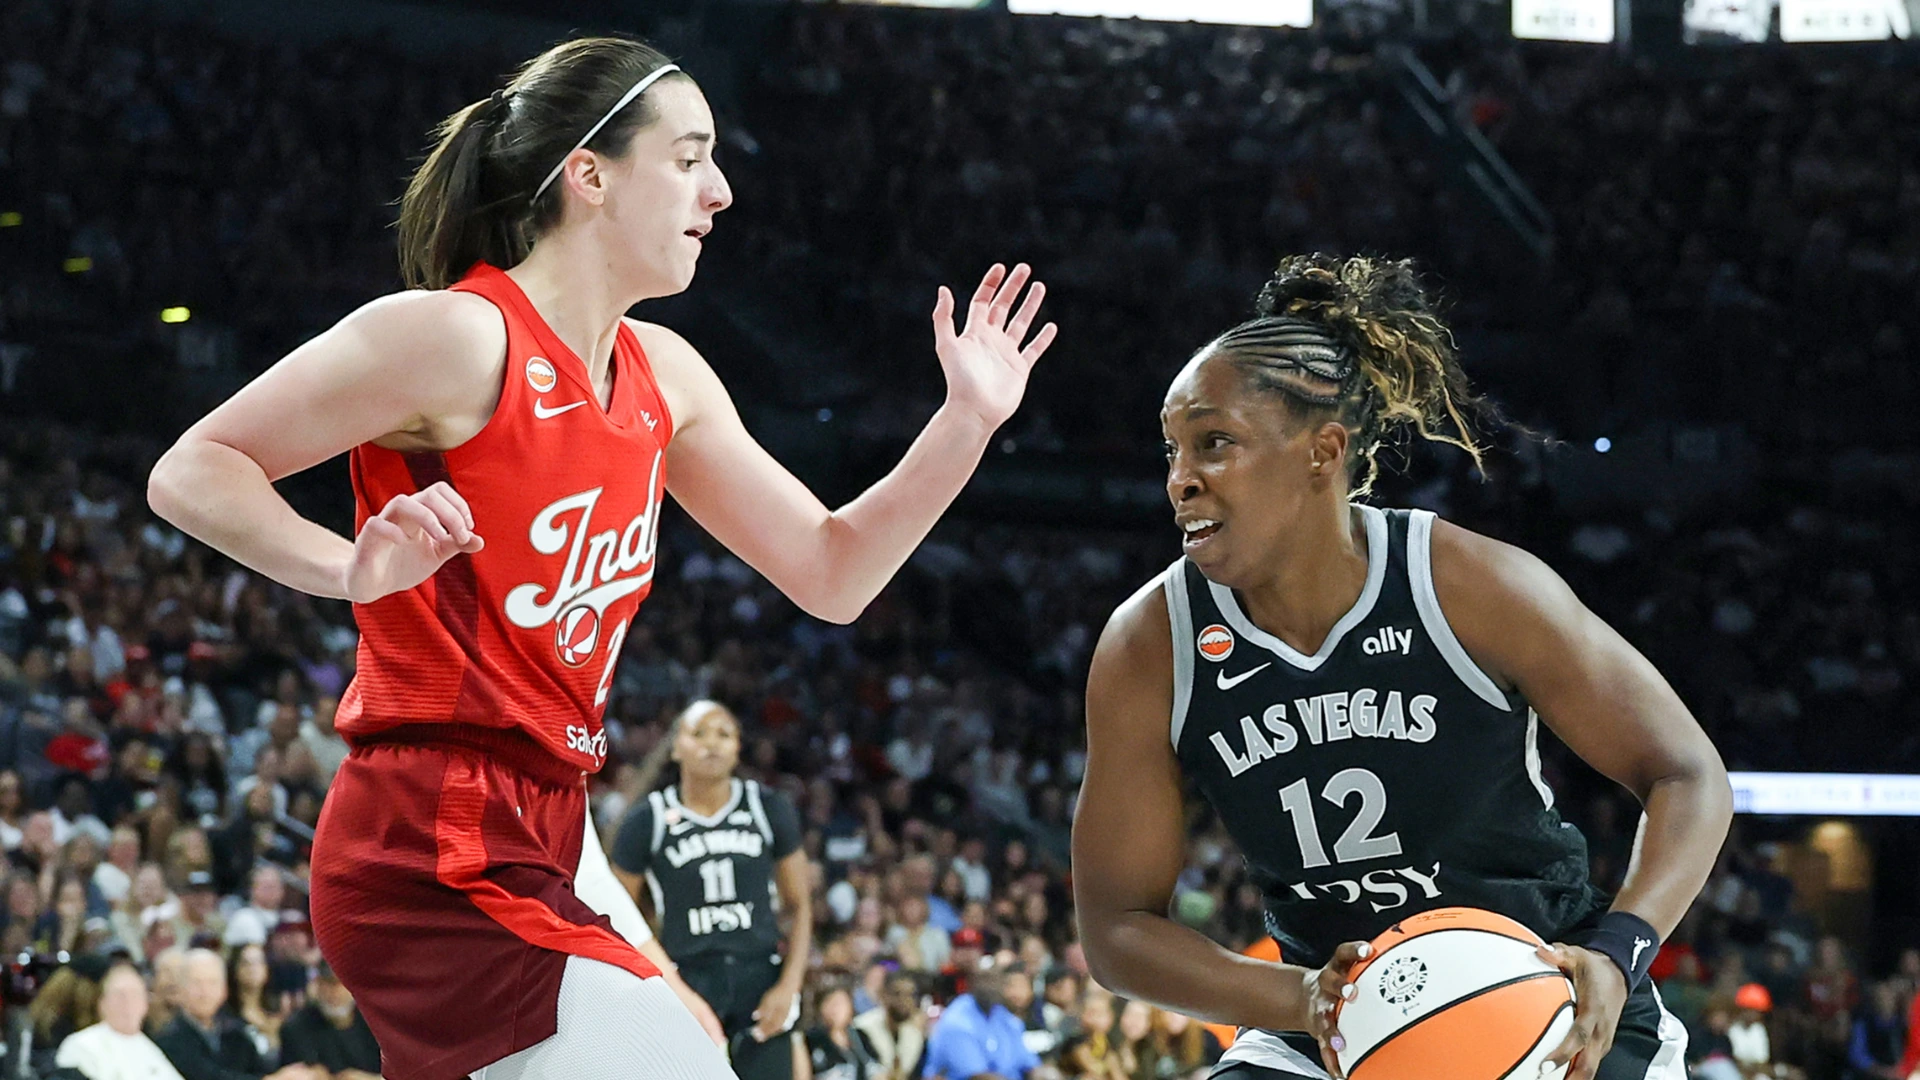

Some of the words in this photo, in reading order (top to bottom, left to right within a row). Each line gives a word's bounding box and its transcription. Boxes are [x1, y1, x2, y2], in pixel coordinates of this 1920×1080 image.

[1362, 626, 1412, 656] ally
[1208, 704, 1298, 778] LAS
[1294, 688, 1438, 745] VEGAS
[1278, 767, 1403, 869] 12
[699, 857, 737, 903] 11
[688, 901, 755, 936] IPSY
